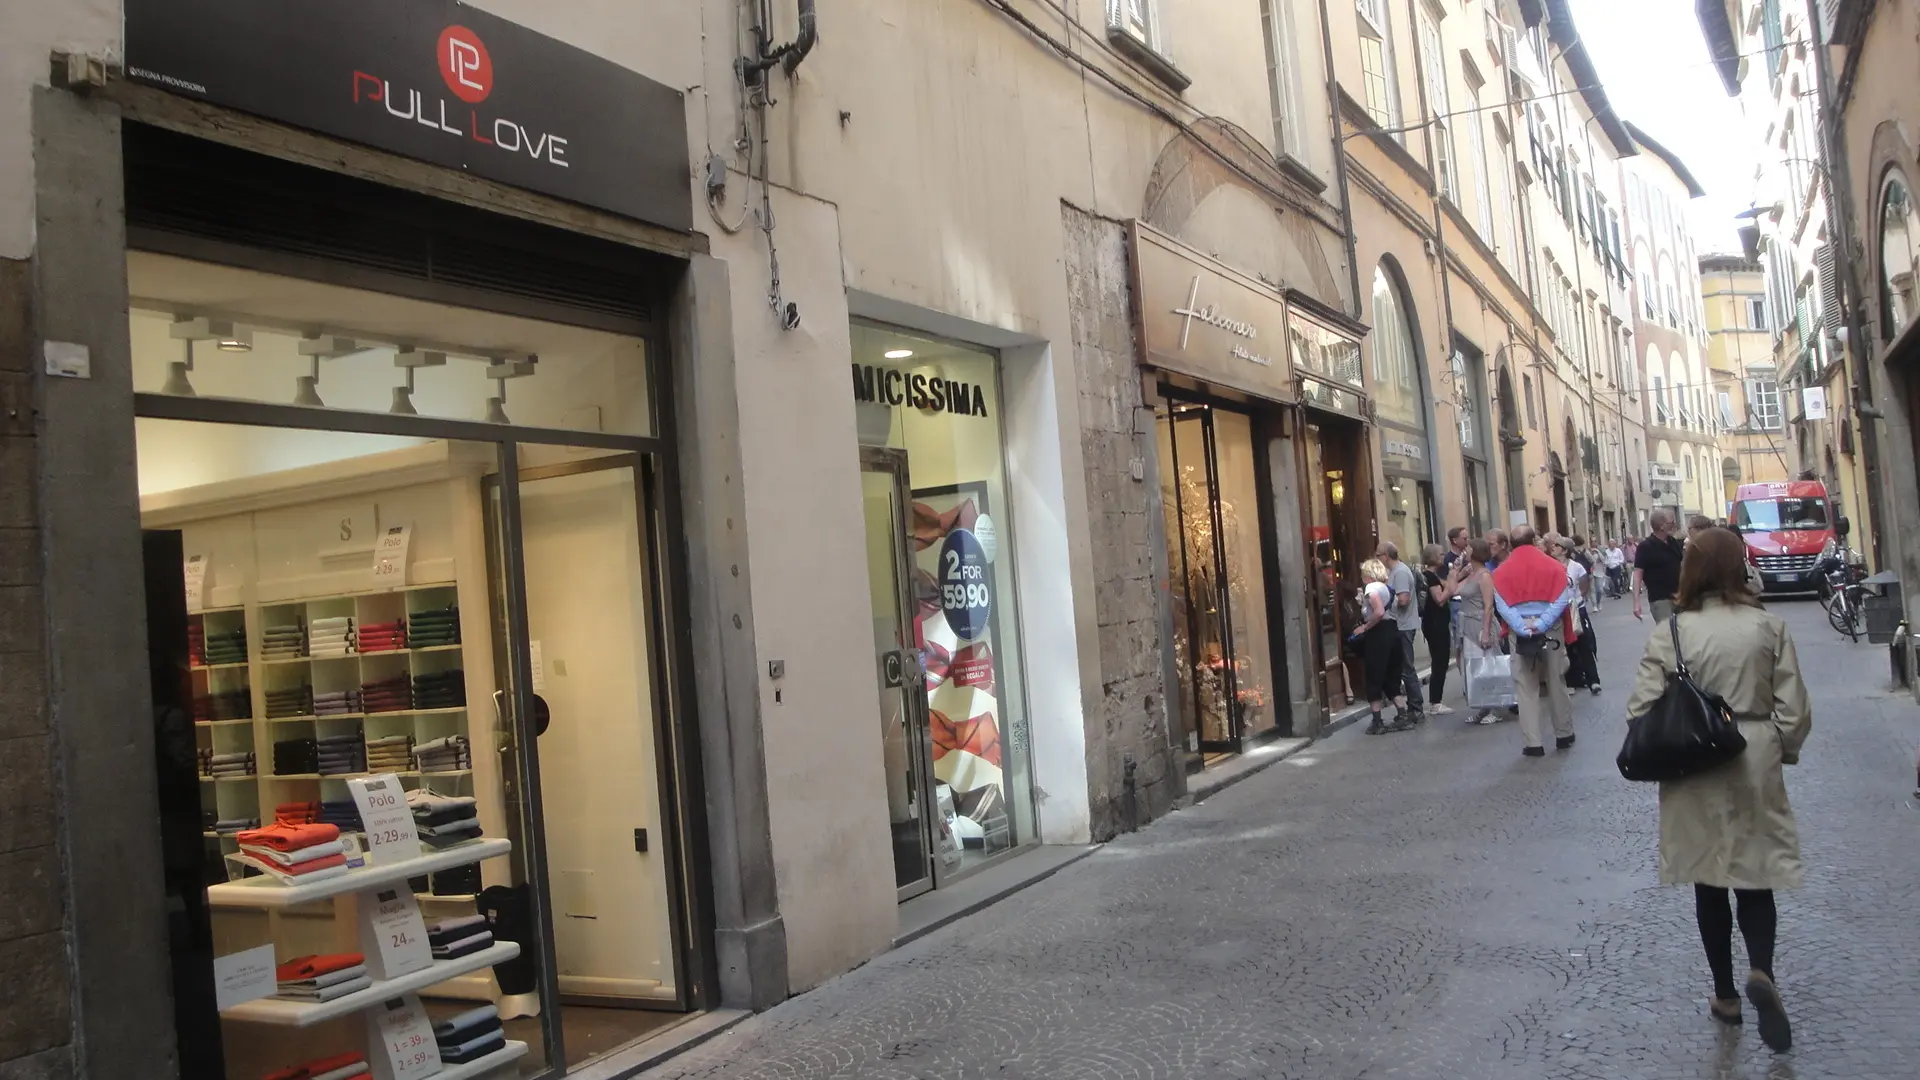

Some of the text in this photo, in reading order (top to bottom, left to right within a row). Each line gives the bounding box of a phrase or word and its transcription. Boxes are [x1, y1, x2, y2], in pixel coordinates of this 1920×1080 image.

[353, 70, 570, 168] PULL LOVE
[340, 518, 352, 541] S
[945, 549, 983, 580] 2 FOR
[368, 794, 395, 808] Polo
